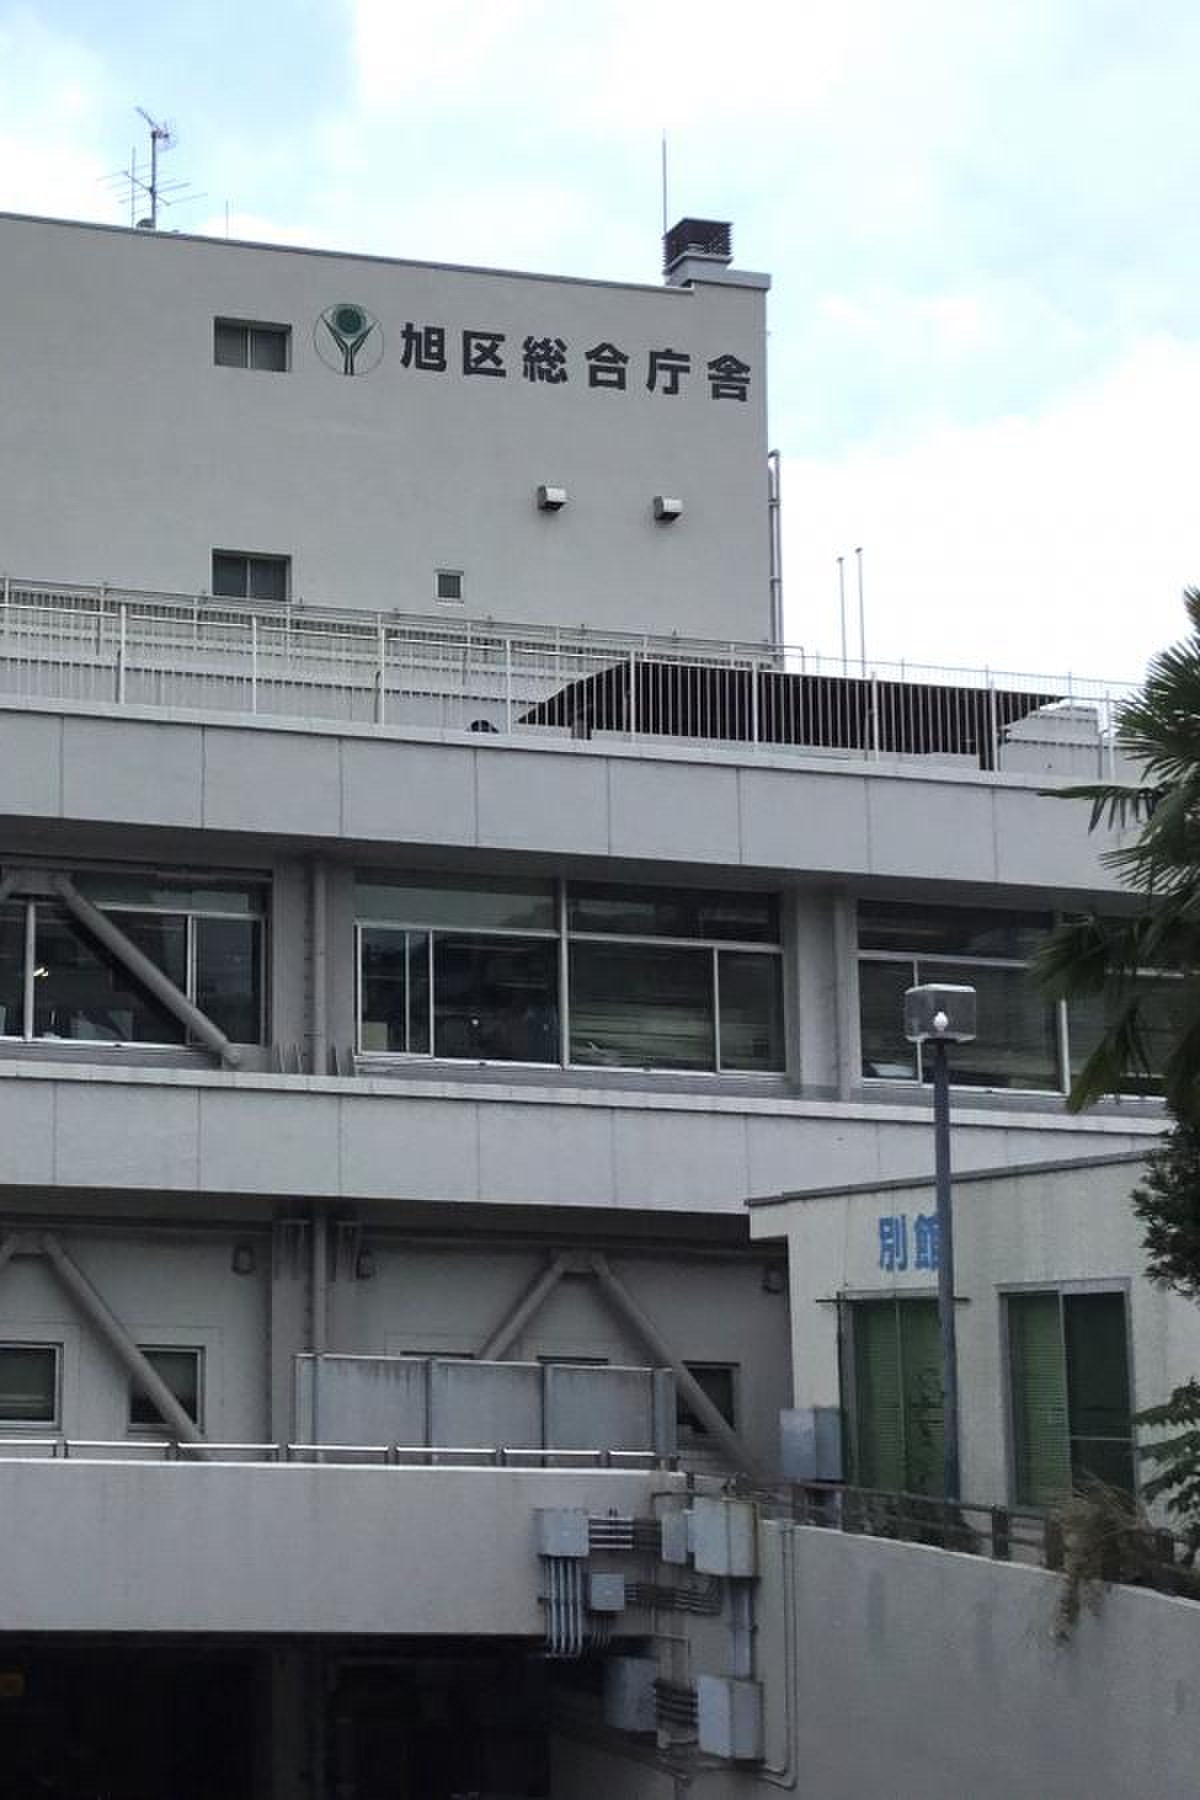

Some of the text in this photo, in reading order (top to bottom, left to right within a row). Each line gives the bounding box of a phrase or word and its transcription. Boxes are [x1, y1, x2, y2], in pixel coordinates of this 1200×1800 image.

[400, 322, 751, 402] 旭区総合庁舎
